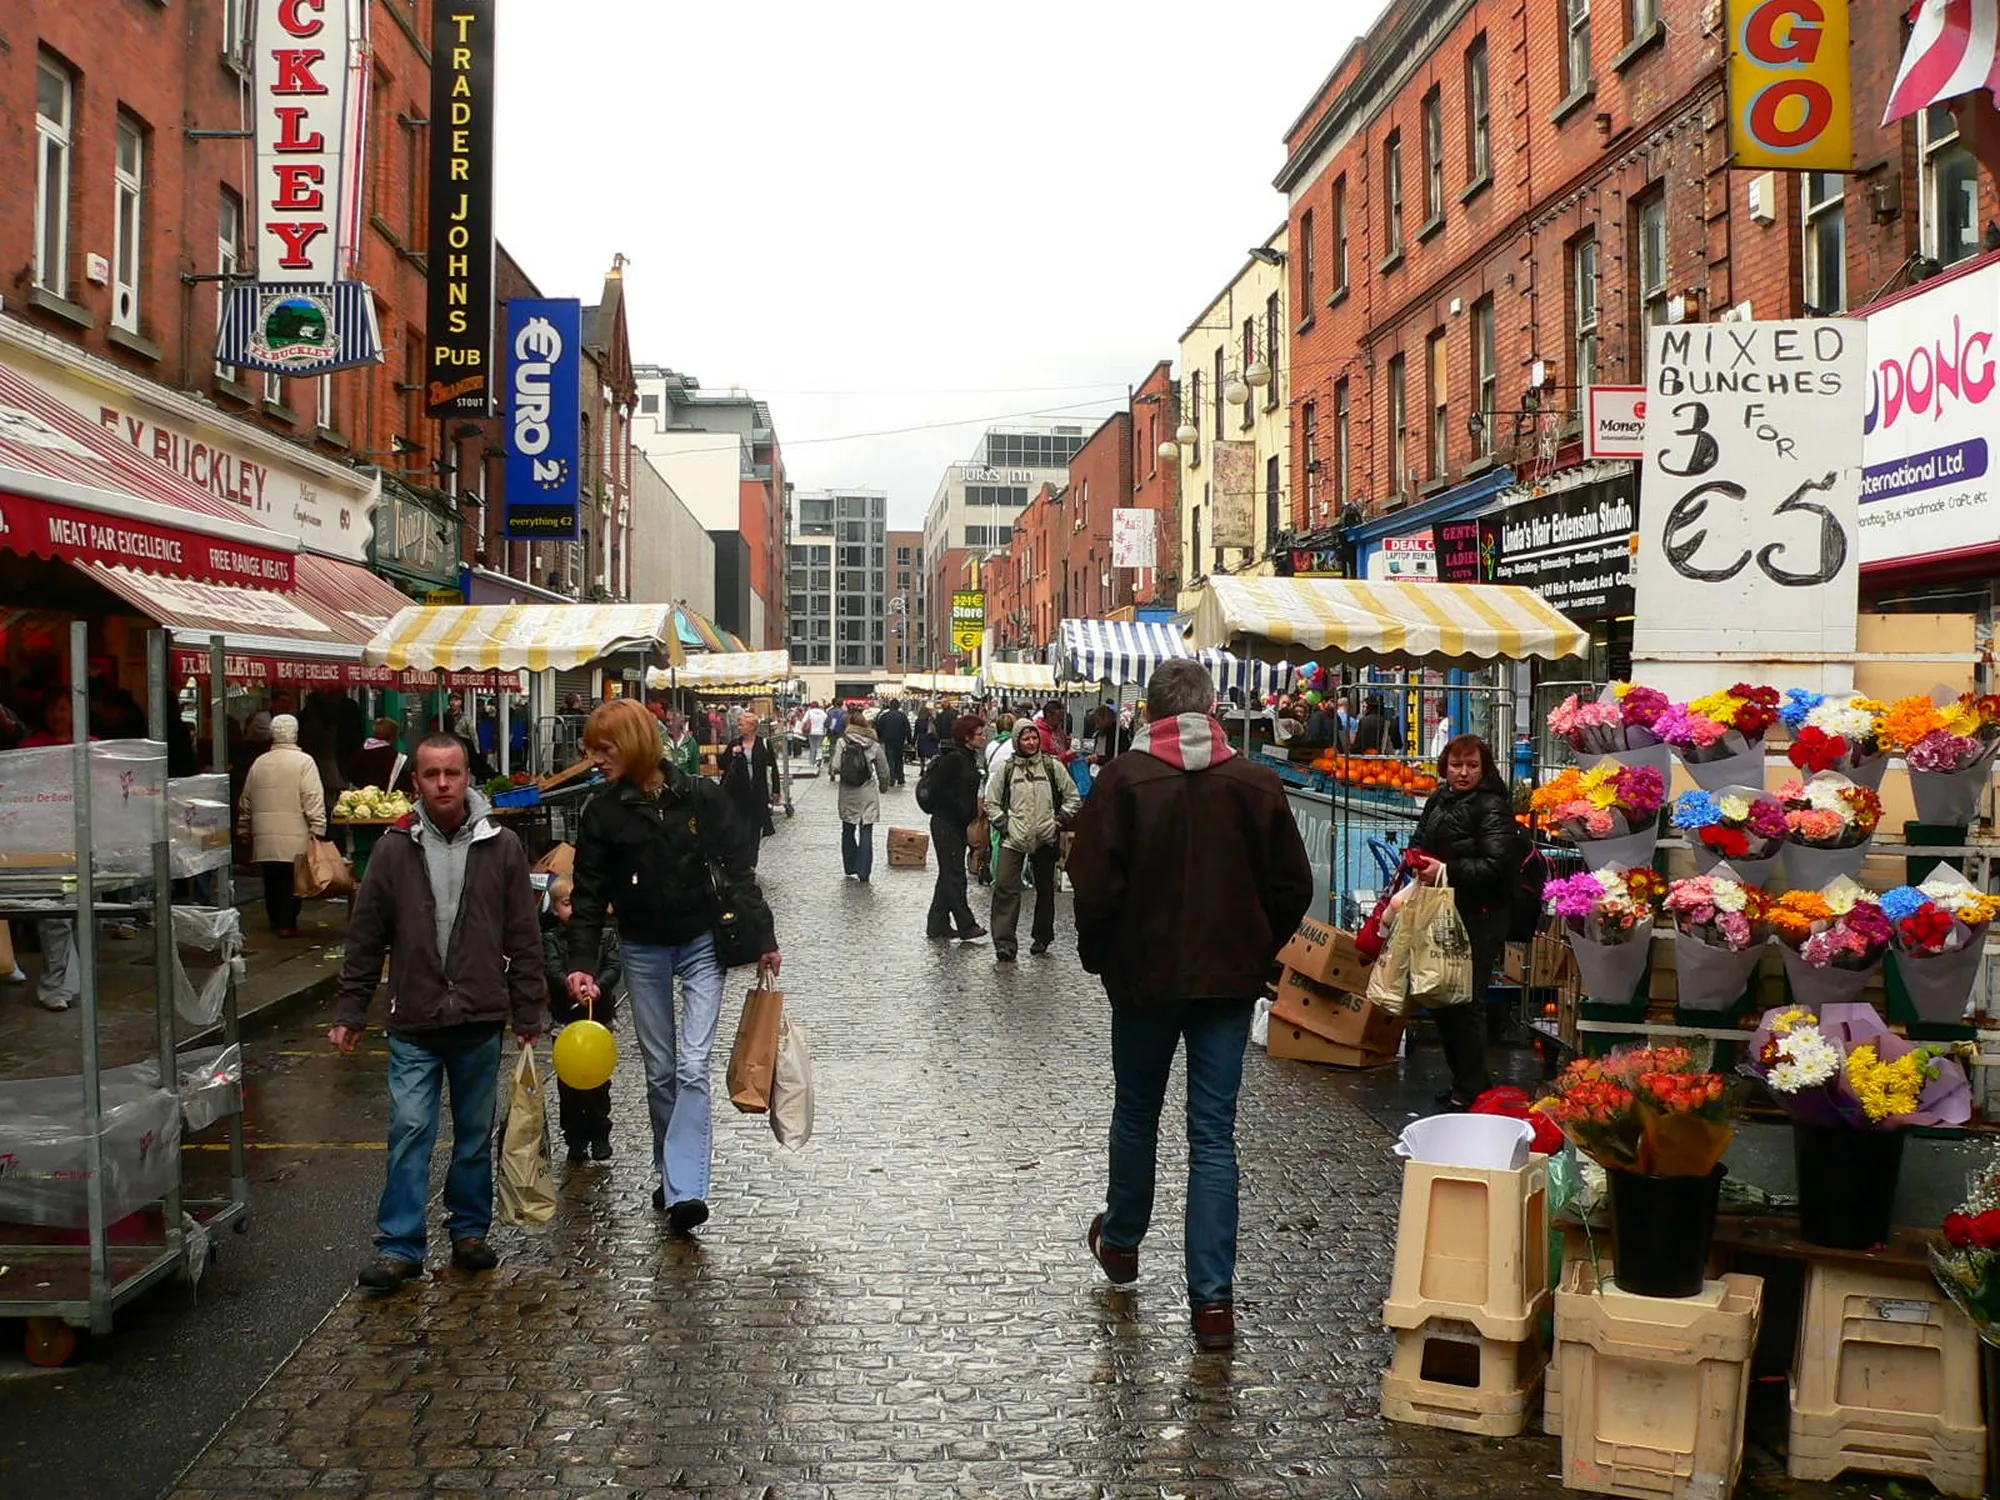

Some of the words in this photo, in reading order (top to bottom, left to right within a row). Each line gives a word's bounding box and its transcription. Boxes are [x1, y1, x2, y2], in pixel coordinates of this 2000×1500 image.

[451, 15, 475, 181] TRADER
[448, 194, 469, 333] JOHNS
[270, 345, 333, 361] BUCKLEY
[1660, 326, 1843, 370] MIXED
[1659, 366, 1842, 396] BUNCHES
[456, 397, 484, 407] STOUT
[1599, 419, 1645, 435] Money
[1657, 401, 1719, 477] 3
[1744, 403, 1799, 461] FOR
[1937, 448, 1965, 476] Ltd.
[960, 467, 1000, 482] JURYS
[1902, 500, 1945, 518] Handmade
[510, 516, 559, 528] everything
[1443, 524, 1477, 540] GENTS
[1501, 521, 1532, 553] Linda's
[1532, 516, 1551, 547] Hair
[1552, 507, 1599, 543] Extension
[1599, 497, 1632, 534] Studio
[49, 516, 87, 548] MEAT
[89, 524, 117, 552] PAR
[117, 530, 183, 564] EXCELLENCE
[1391, 540, 1420, 550] DEAL
[209, 547, 232, 571] FREE
[231, 551, 263, 578] RANGE
[262, 555, 290, 582] MEATS
[1553, 580, 1568, 595] Hair
[1569, 577, 1598, 593] Product
[1600, 573, 1613, 588] And
[953, 607, 984, 618] Store
